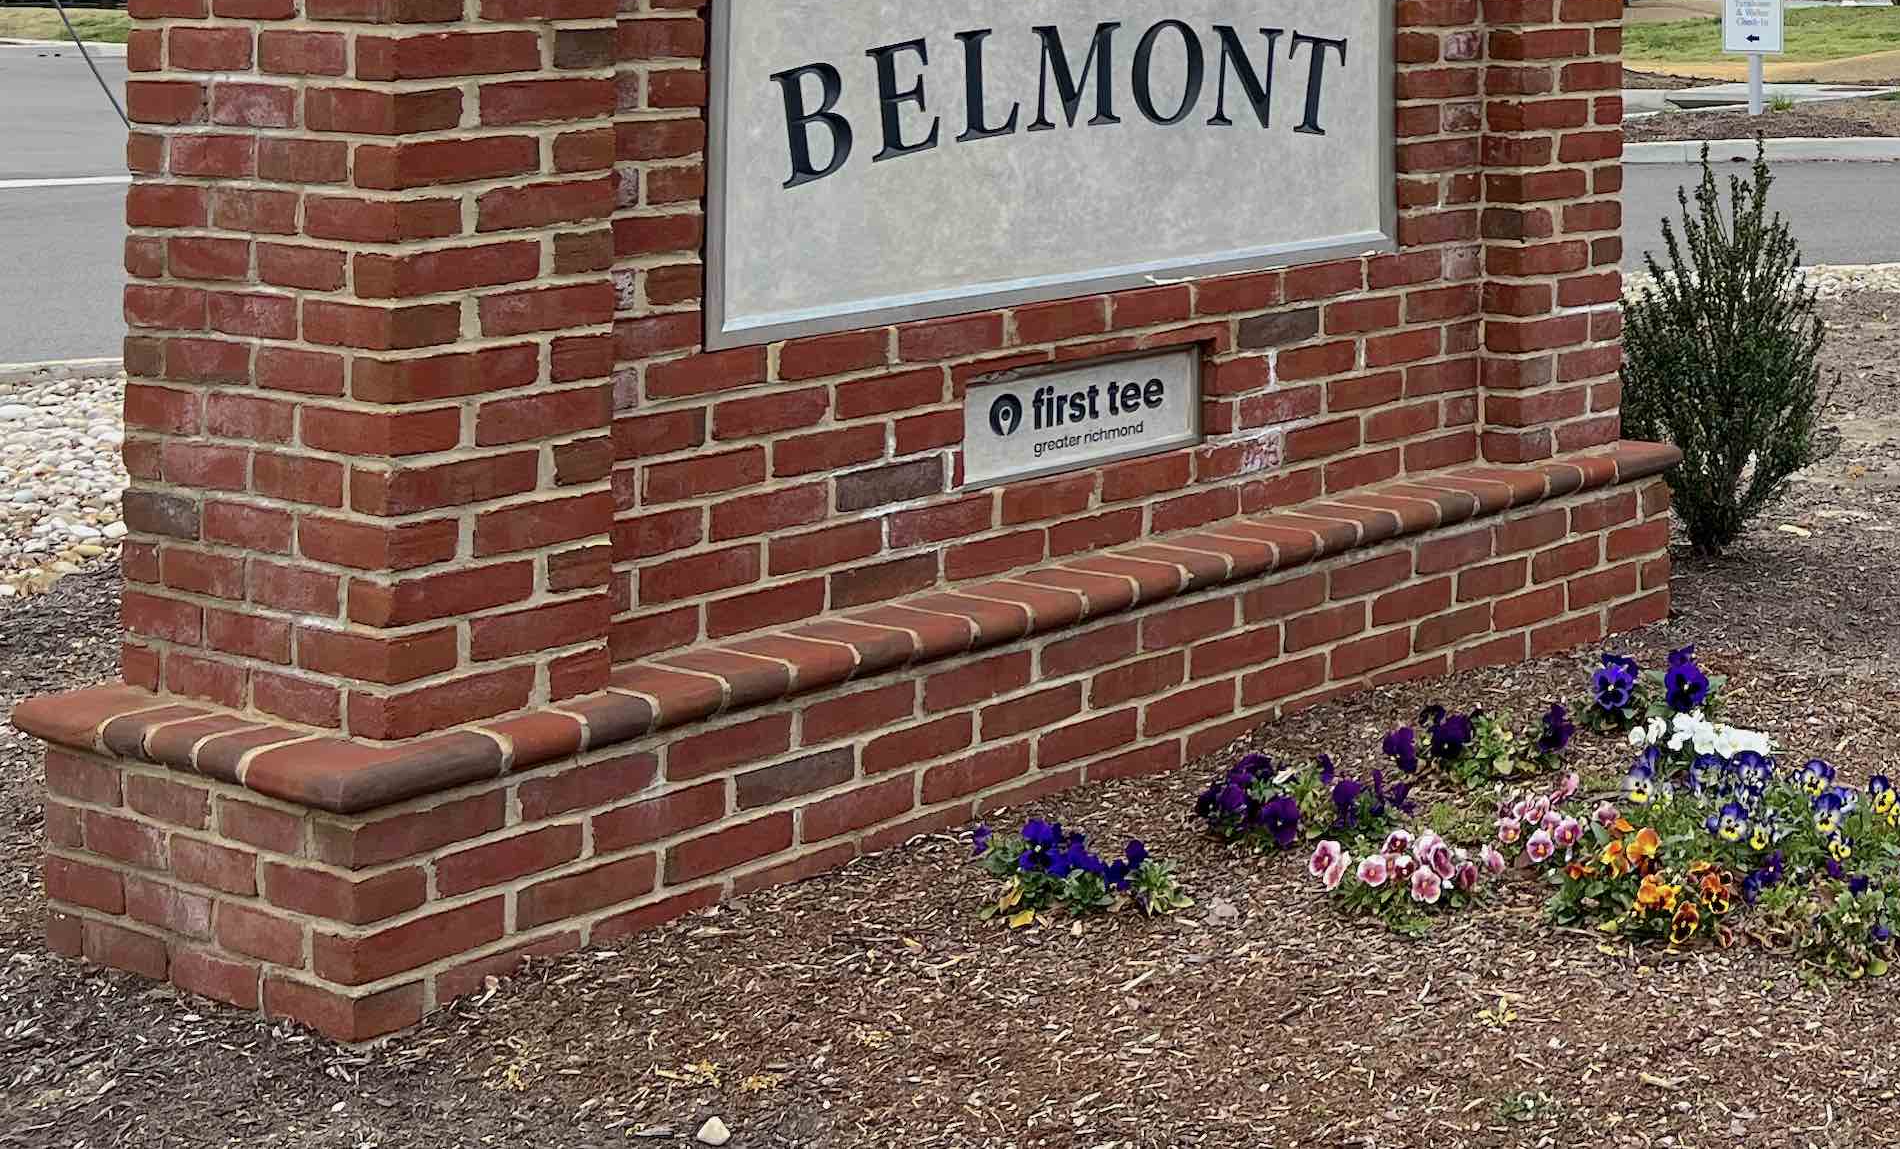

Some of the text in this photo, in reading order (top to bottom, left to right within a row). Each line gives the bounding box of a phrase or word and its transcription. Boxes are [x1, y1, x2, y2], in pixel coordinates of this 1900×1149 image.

[769, 18, 1347, 190] BELMONT
[1032, 378, 1165, 430] first tee
[1033, 420, 1144, 458] greater richmond
